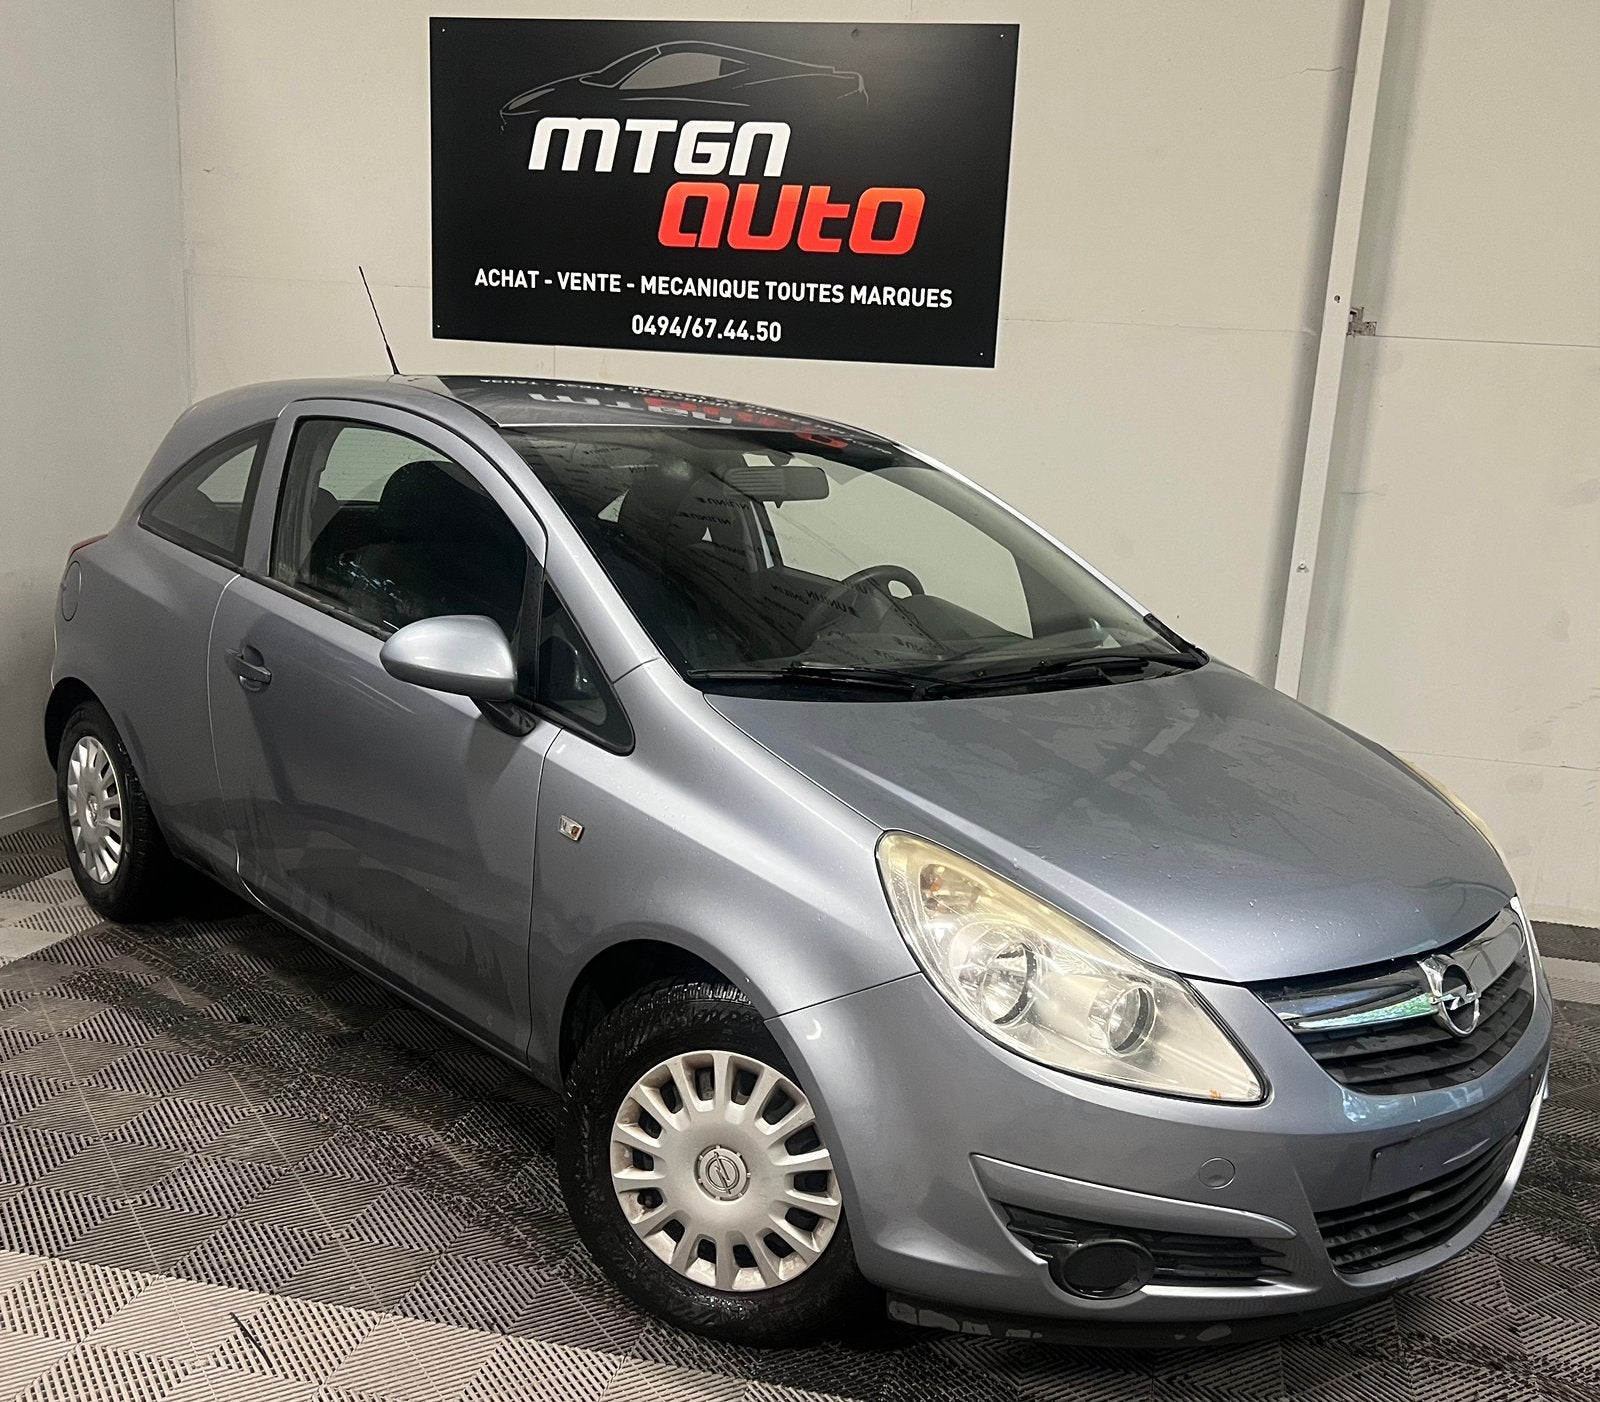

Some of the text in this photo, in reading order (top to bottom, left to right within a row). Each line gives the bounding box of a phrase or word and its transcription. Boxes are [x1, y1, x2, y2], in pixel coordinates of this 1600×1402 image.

[474, 267, 540, 289] ACHAT
[556, 271, 622, 293] VENTE
[640, 275, 760, 300] MECANIQUE
[764, 280, 845, 304] TOUTES
[850, 284, 953, 310] MARQUES
[631, 314, 782, 342] 0494/67.44.50
